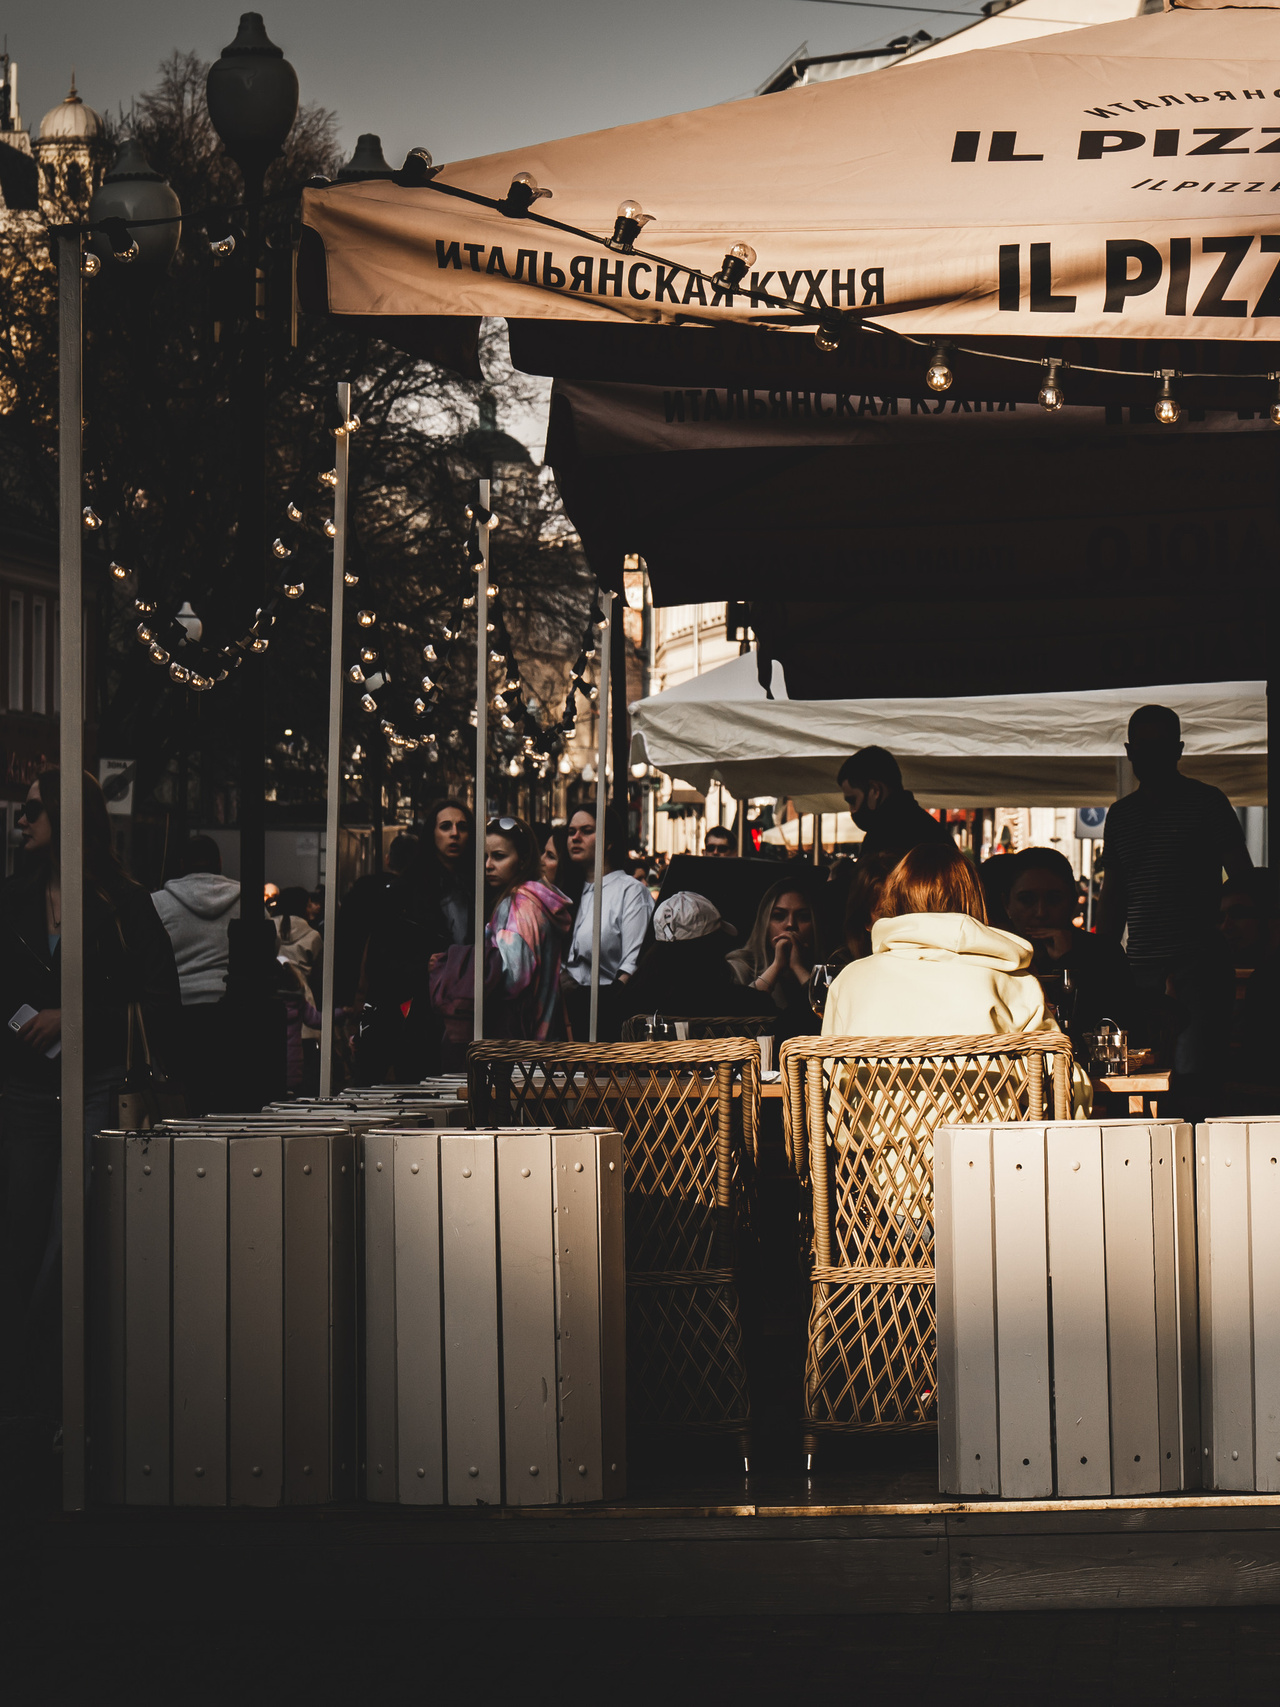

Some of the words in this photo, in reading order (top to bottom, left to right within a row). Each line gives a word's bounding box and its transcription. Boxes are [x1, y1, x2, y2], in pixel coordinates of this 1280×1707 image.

[950, 130, 1044, 162] IL
[750, 267, 884, 308] КУХНЯ
[998, 242, 1077, 313] IL
